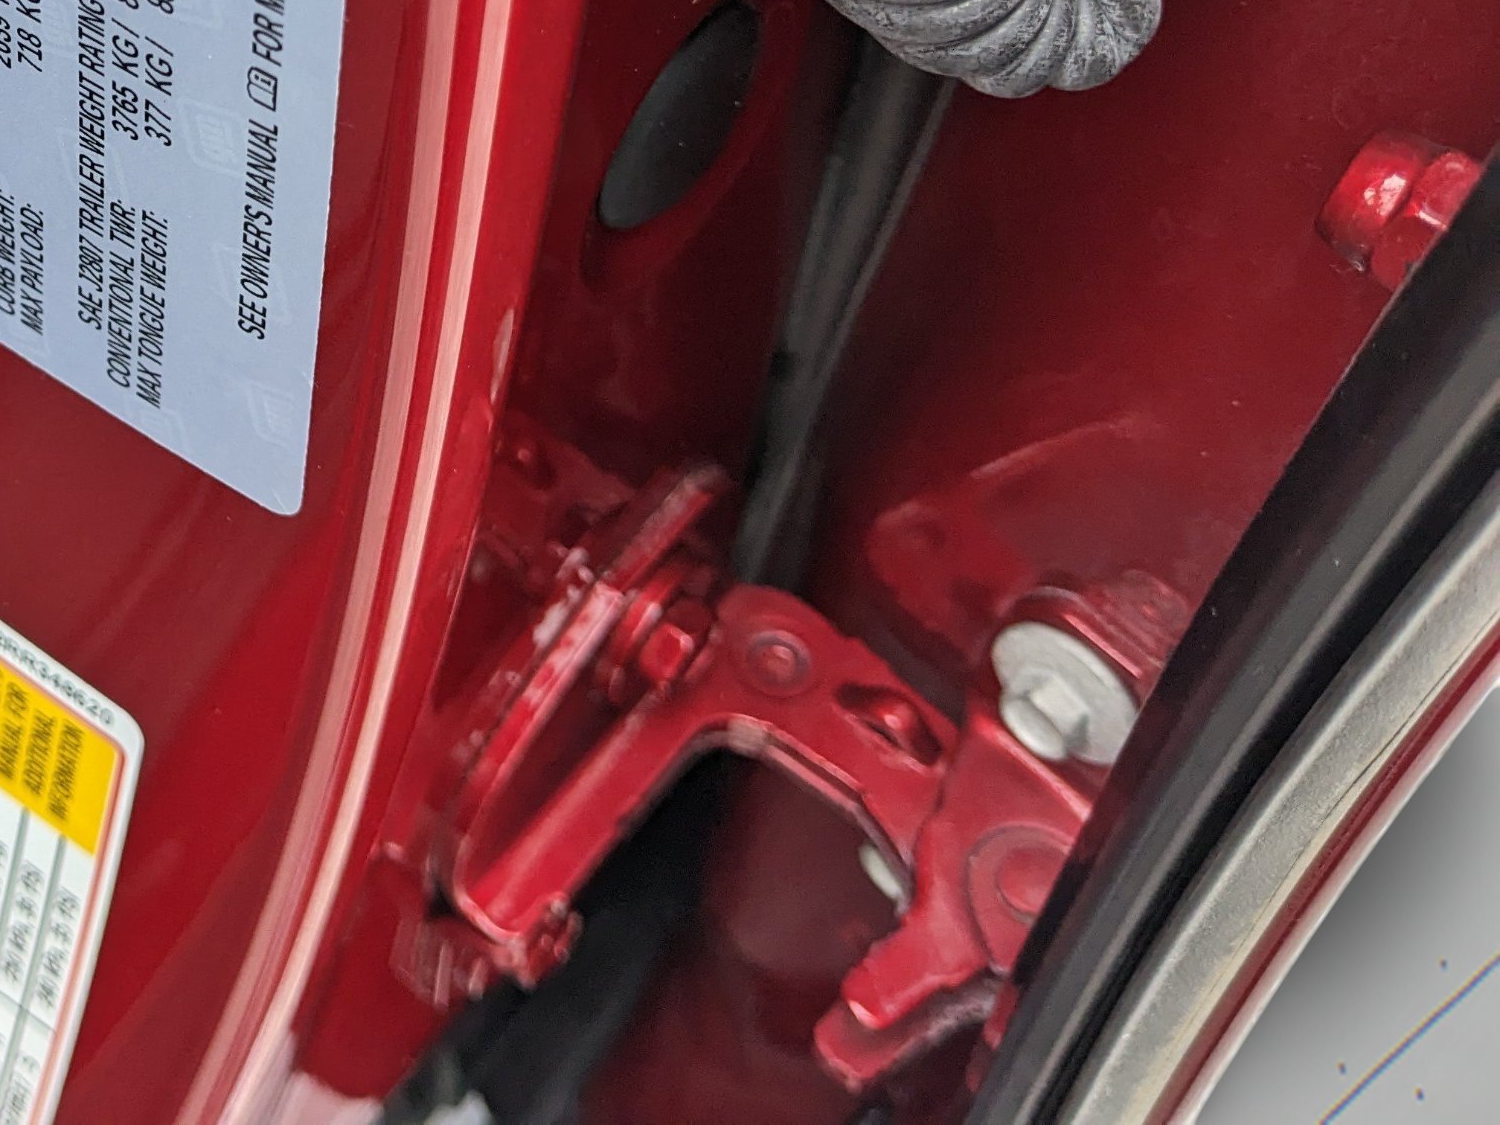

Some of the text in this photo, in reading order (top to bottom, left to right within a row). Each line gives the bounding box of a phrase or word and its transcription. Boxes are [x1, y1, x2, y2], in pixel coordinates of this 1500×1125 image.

[16, 27, 43, 73] 718
[251, 12, 284, 67] FOR
[78, 70, 105, 157] WEIGHT
[111, 80, 139, 141] 3765
[144, 99, 172, 147] 377
[245, 118, 278, 210] MANUAL
[79, 153, 105, 238] TRAILER
[109, 199, 136, 250] TWR:
[19, 203, 44, 294] PAYLOAD:
[78, 235, 104, 292] J2807
[140, 209, 169, 291] WEIGHT:
[240, 204, 273, 299] OWNER'S
[19, 289, 43, 335] MAX
[77, 285, 102, 330] SAE
[106, 250, 135, 388] CONVENTIONAL
[137, 285, 166, 366] TONGUE
[237, 294, 267, 340] SEE
[136, 362, 162, 409] MAX
